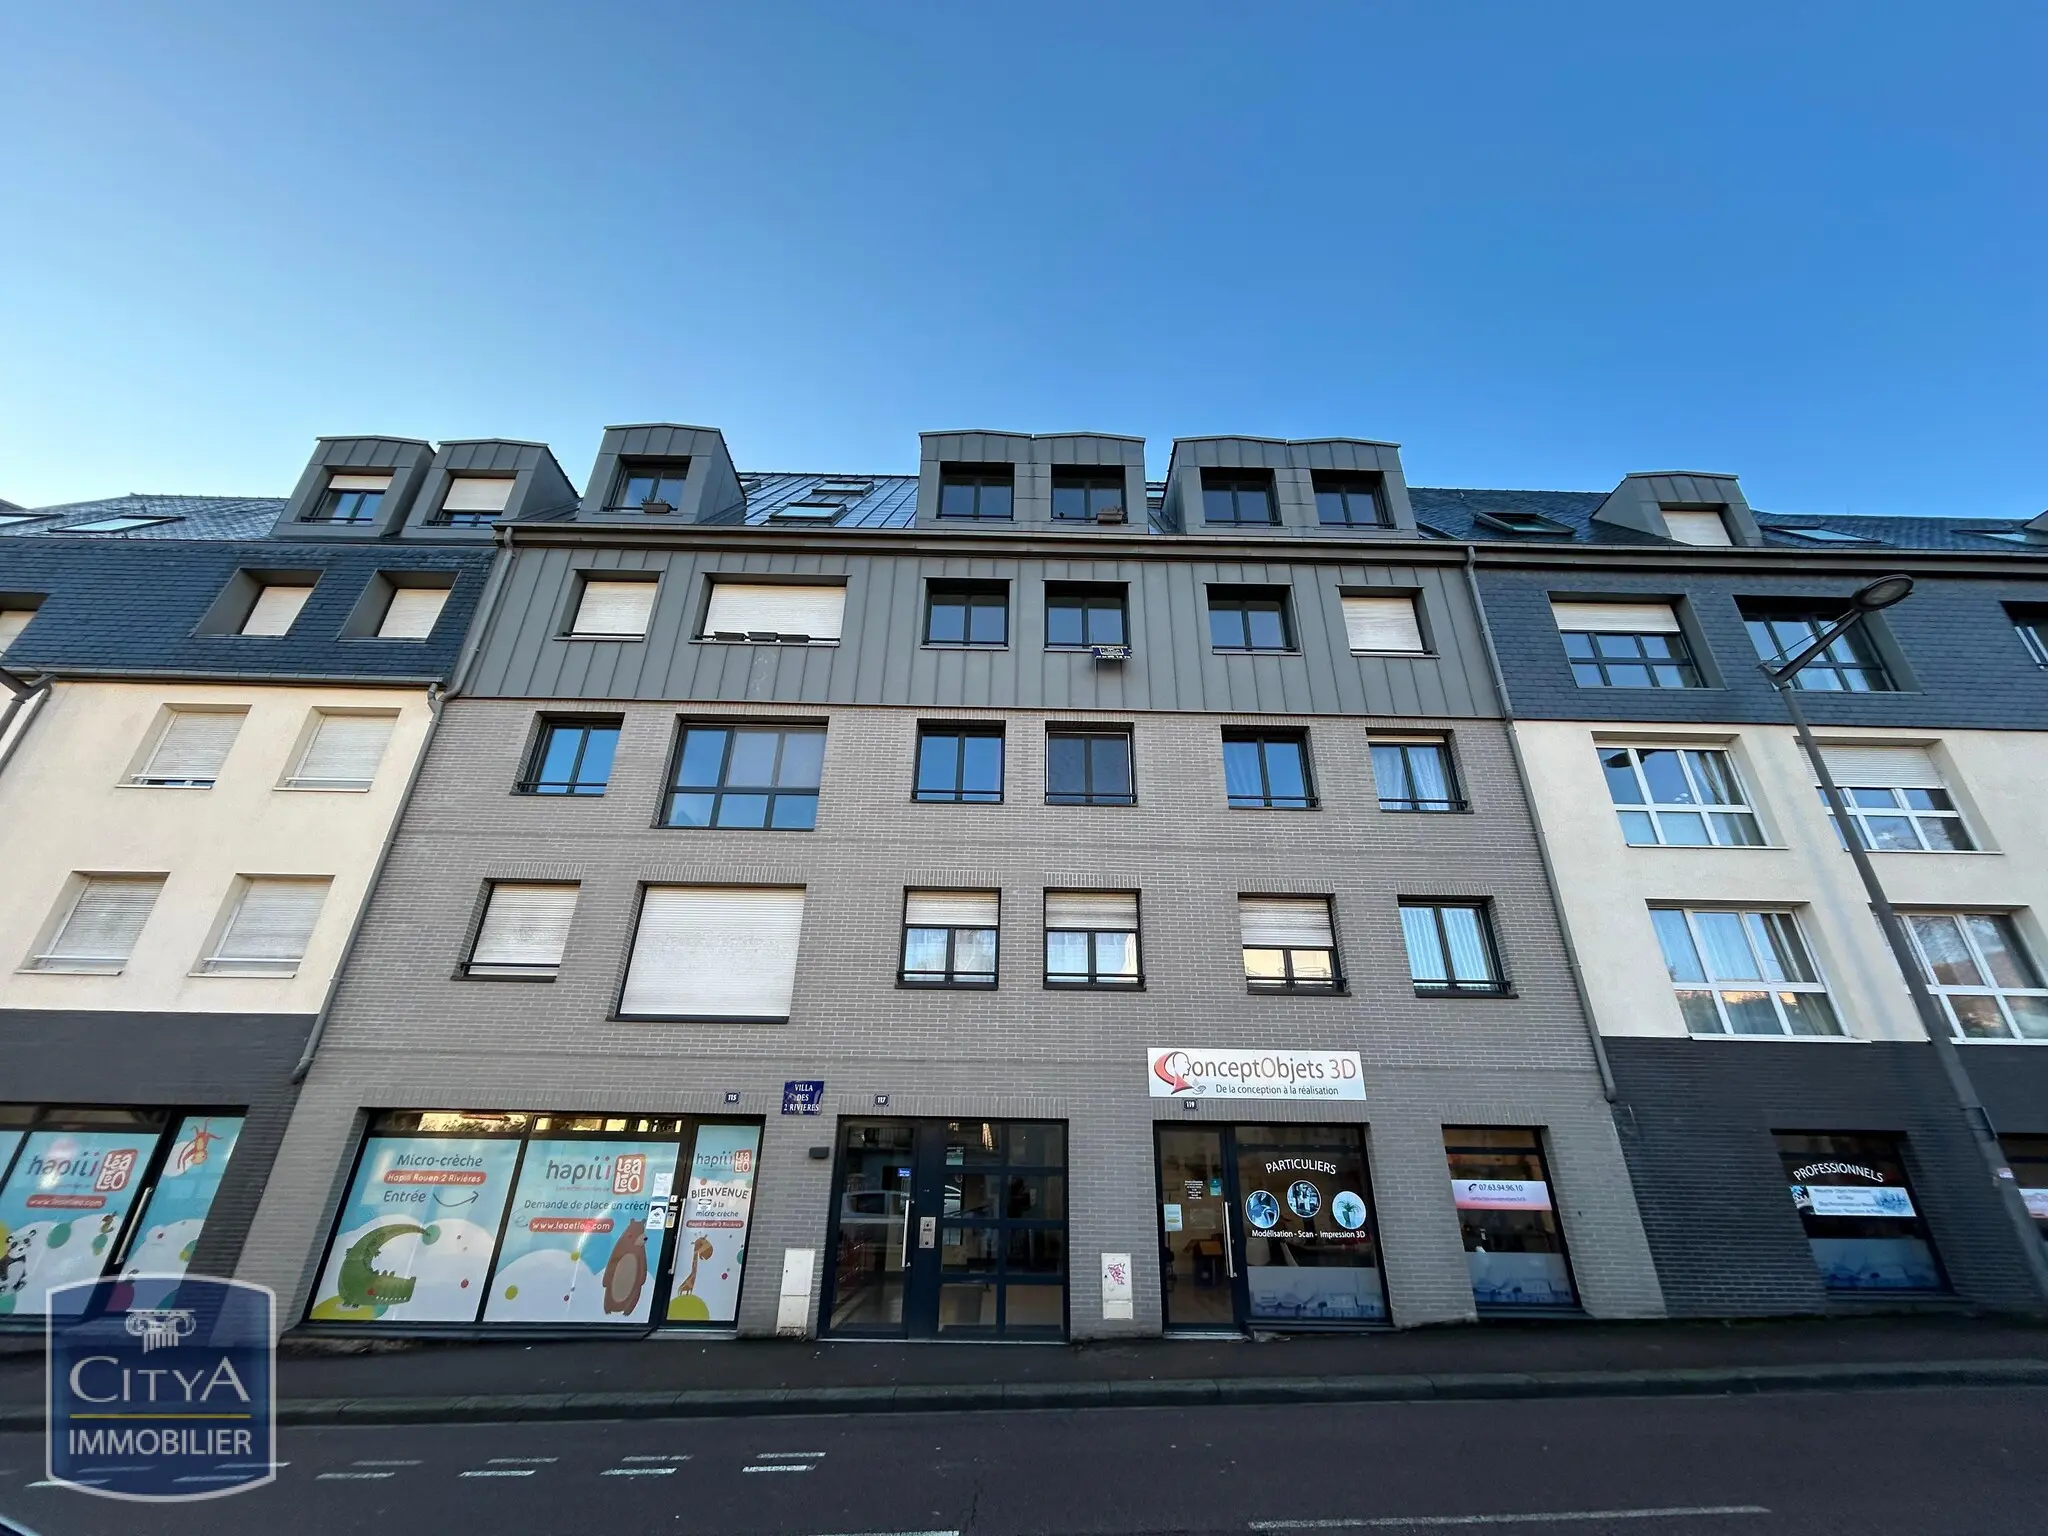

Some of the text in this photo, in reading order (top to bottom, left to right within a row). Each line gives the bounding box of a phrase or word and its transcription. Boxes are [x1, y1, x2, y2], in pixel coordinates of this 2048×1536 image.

[1328, 1058, 1356, 1079] 3D
[794, 1083, 813, 1091] VILLA
[1216, 1083, 1339, 1096] De la conception à la réalisation
[796, 1093, 809, 1101] DES
[783, 1103, 788, 1111] 2
[396, 1154, 484, 1167] Micro-crèche
[1265, 1158, 1337, 1175] PARTICULIERS
[387, 1173, 481, 1183] Hapi Rouen 2 Rivières
[1793, 1162, 1884, 1183] PROFESSIONNELS
[383, 1190, 427, 1203] Entrée
[691, 1187, 749, 1199] BIENVENUE
[524, 1200, 650, 1212] Demande de place en crèch
[695, 1210, 739, 1218] micro-crèche
[1298, 1230, 1314, 1238] Scan
[1320, 1230, 1355, 1239] Impression
[1356, 1230, 1366, 1238] 3D
